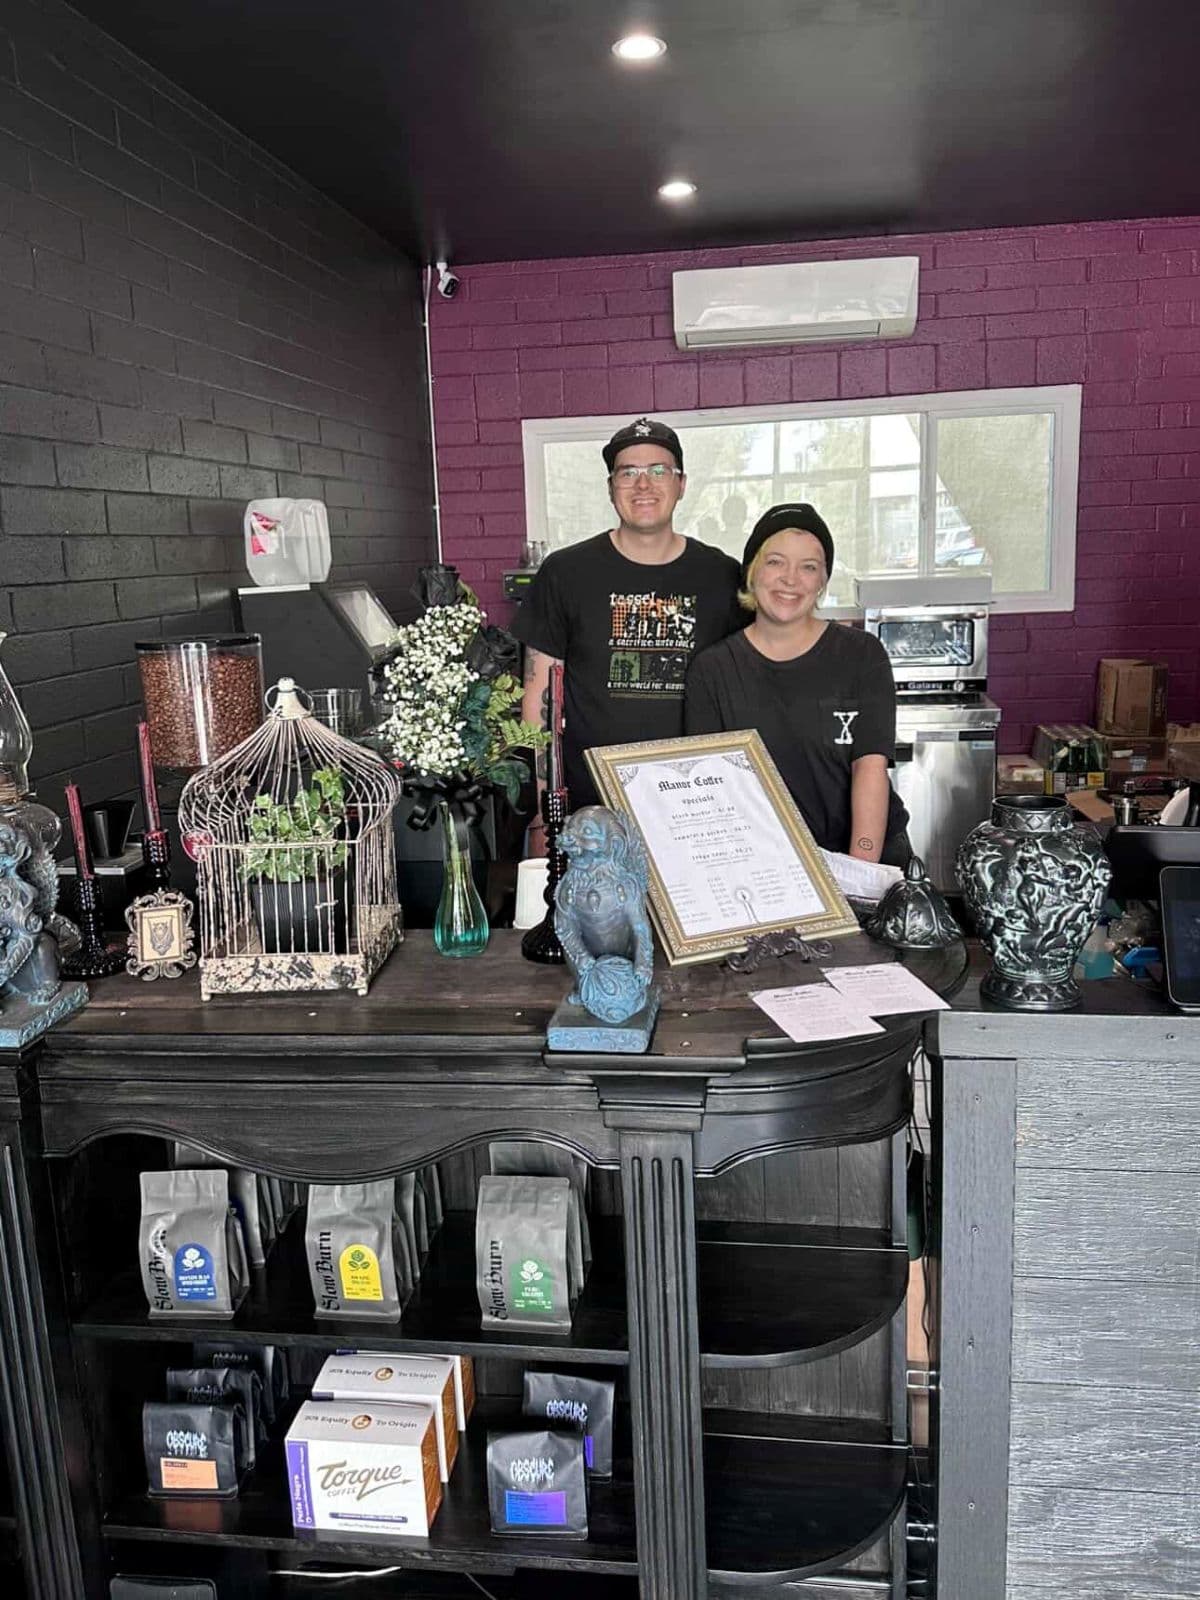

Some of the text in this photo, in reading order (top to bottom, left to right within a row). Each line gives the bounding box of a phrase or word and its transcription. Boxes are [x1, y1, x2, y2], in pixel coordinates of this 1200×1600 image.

[907, 681, 943, 690] Galaxy
[658, 780, 691, 792] Manor
[315, 1231, 340, 1311] Slow Burn
[483, 1240, 509, 1320] Slow Burn
[153, 1277, 173, 1310] Slow
[320, 1416, 349, 1425] Equity
[388, 1420, 417, 1428] Origin
[317, 1459, 412, 1501] Torque
